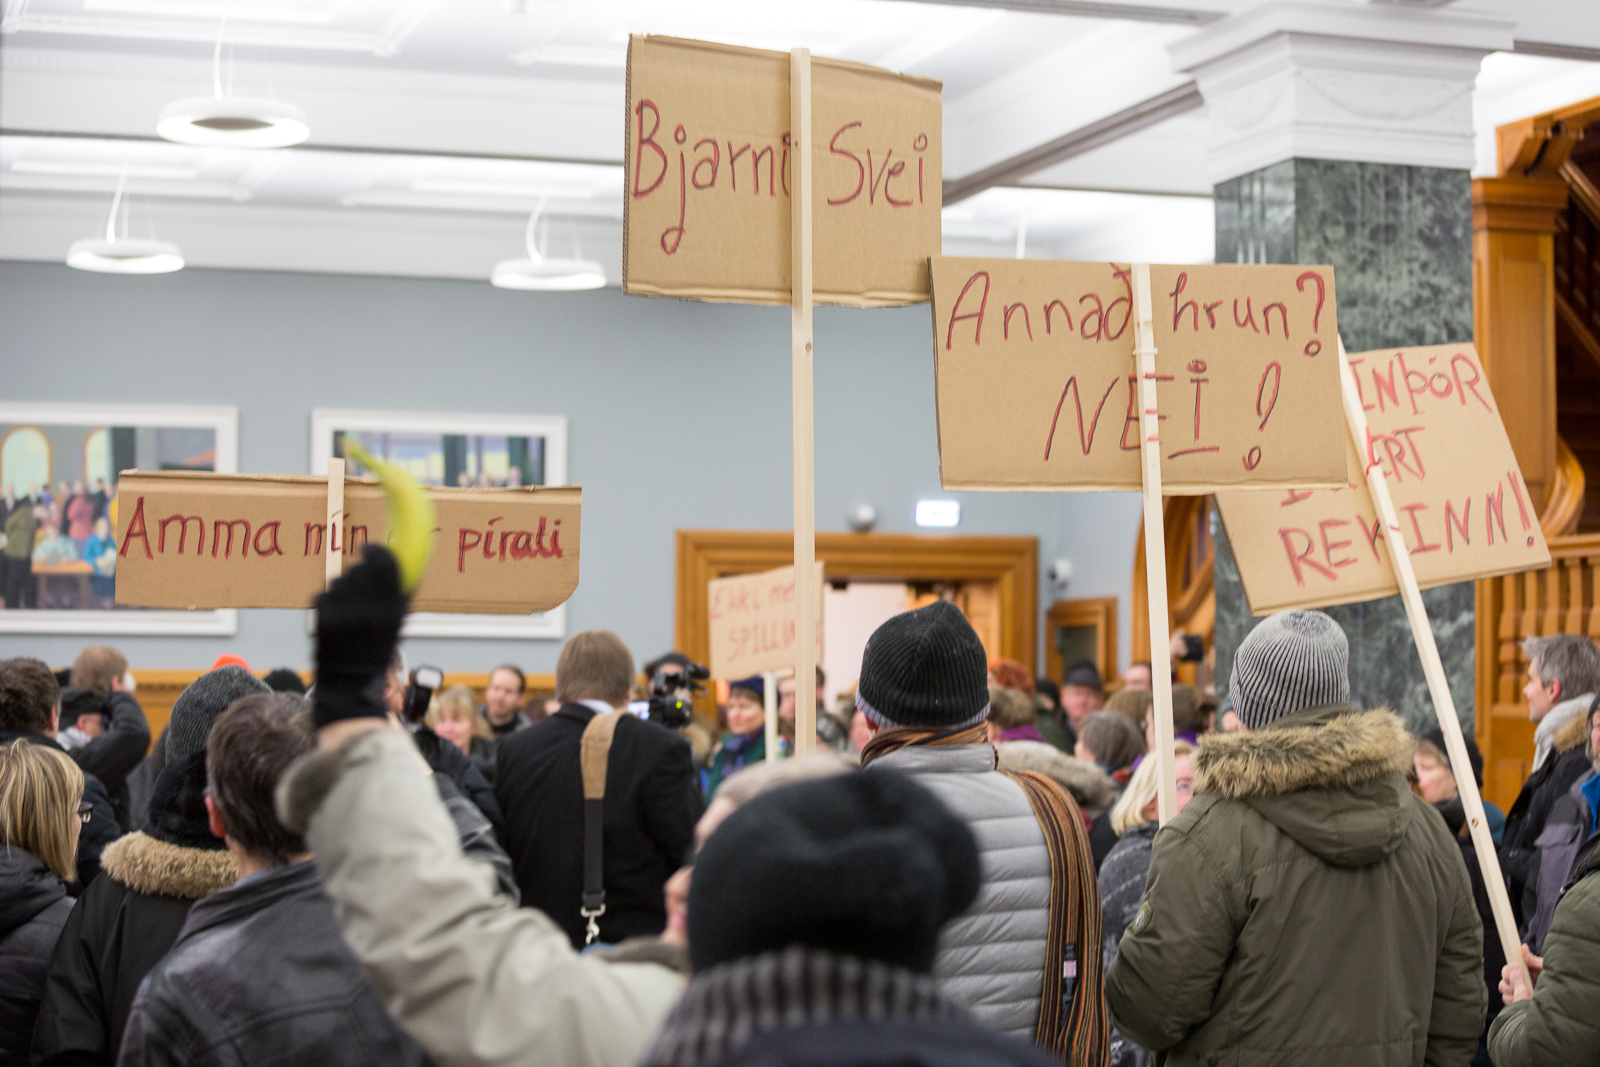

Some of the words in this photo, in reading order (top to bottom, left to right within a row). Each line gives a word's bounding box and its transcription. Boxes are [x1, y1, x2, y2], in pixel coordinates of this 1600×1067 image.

[633, 98, 791, 255] Bjarni
[827, 120, 928, 208] Svei
[1169, 270, 1326, 357] hrun?
[119, 496, 283, 561] Amma
